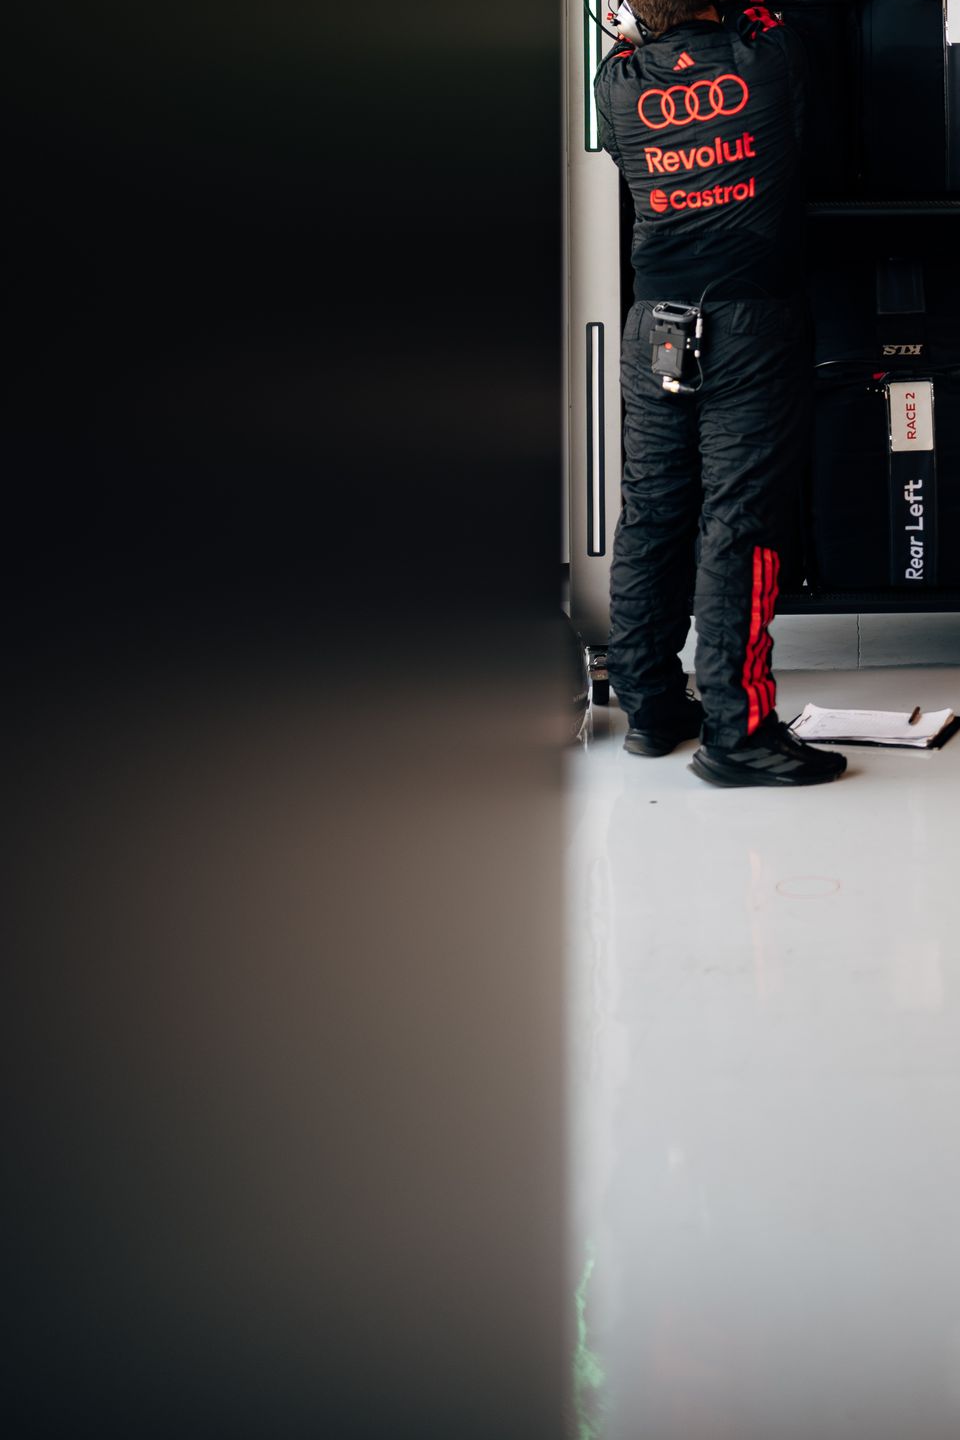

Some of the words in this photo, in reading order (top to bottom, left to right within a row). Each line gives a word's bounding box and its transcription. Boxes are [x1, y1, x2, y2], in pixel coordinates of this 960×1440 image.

[643, 130, 757, 174] Revolut
[669, 175, 757, 211] Castrol
[882, 343, 924, 357] KLS
[905, 392, 915, 400] 2
[906, 403, 917, 440] RACE
[903, 479, 924, 531] Left
[904, 535, 924, 580] Rear
